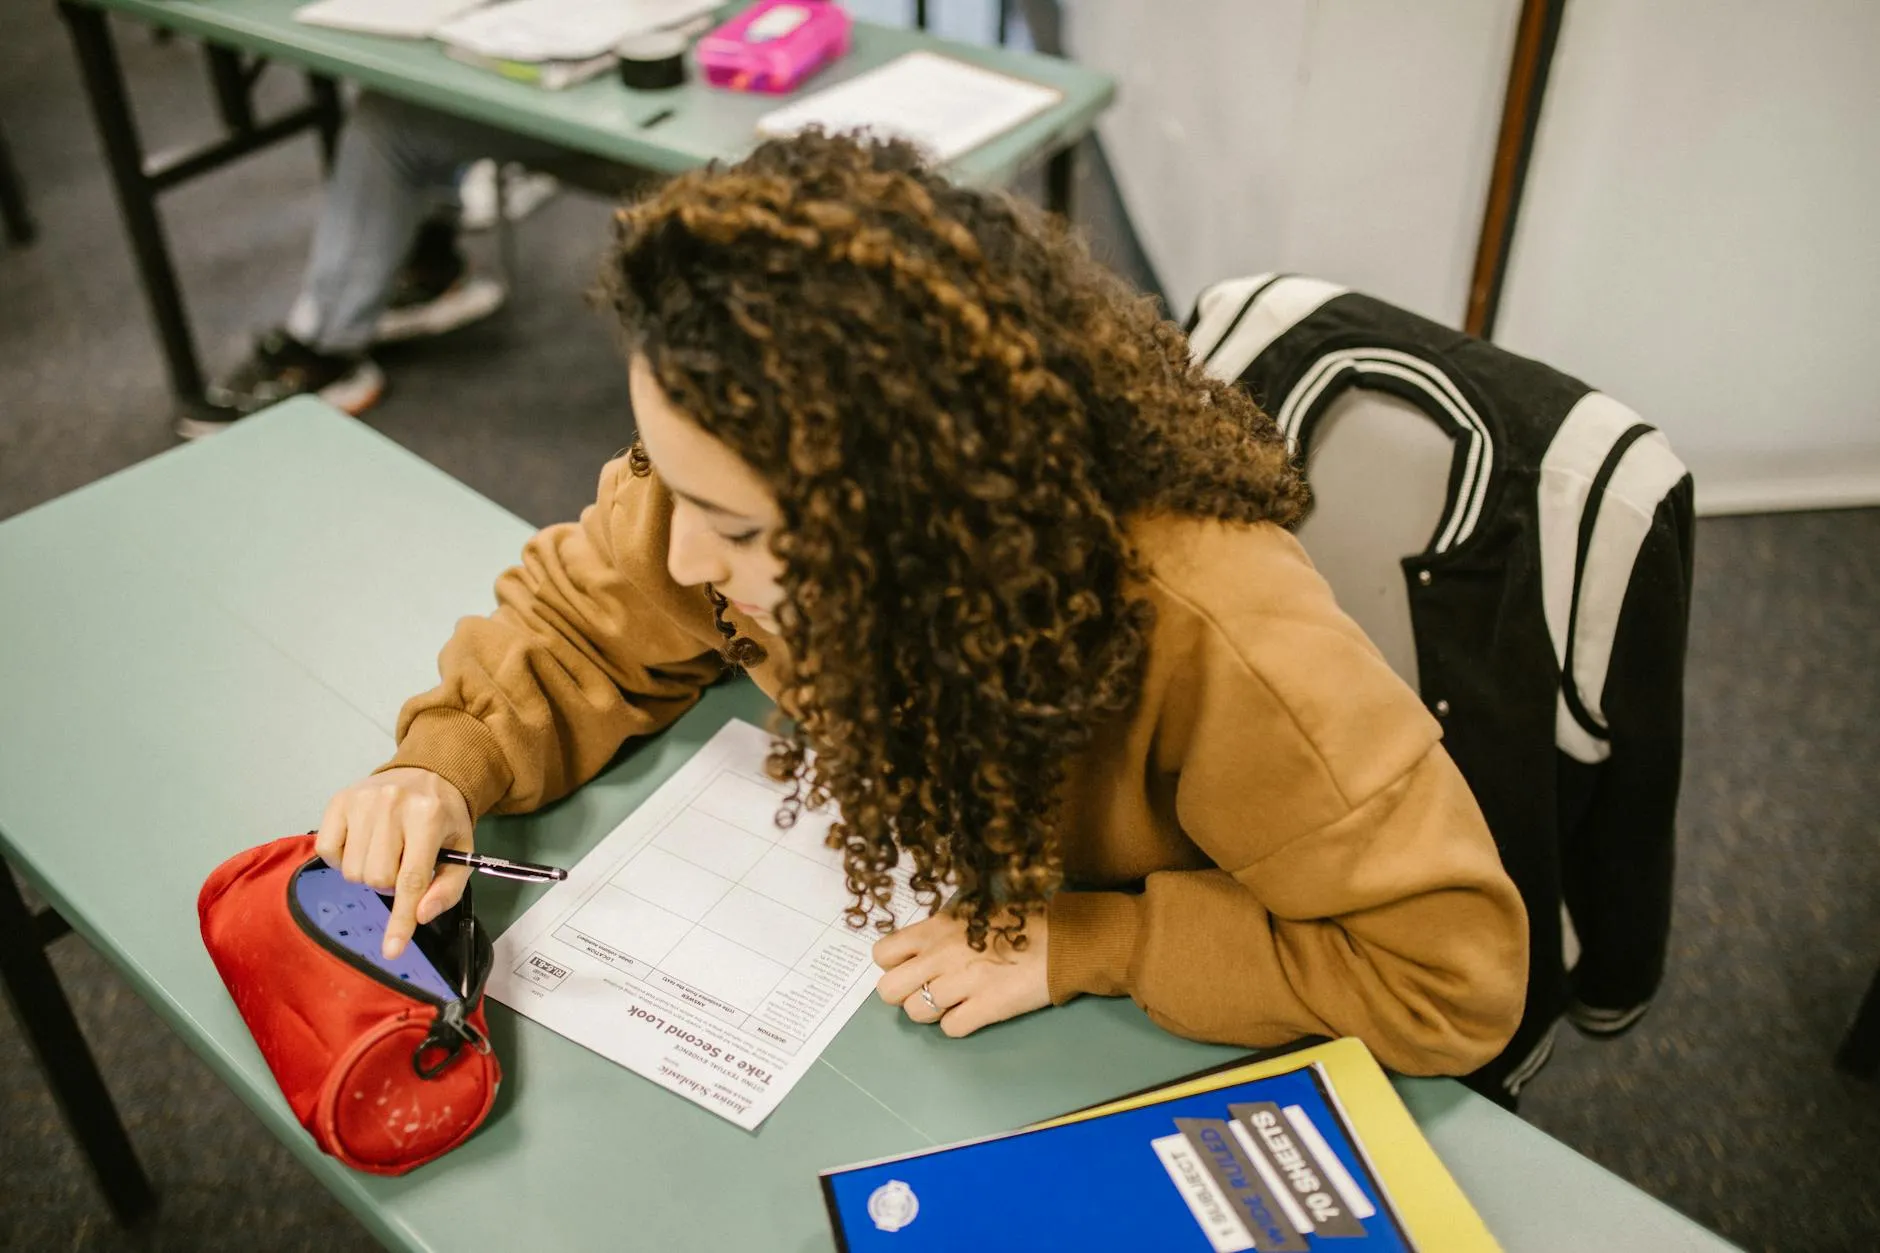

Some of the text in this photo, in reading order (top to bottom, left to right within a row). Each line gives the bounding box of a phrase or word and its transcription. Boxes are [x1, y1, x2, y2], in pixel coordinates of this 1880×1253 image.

[586, 946, 613, 961] LOCATION
[531, 957, 565, 977] RI.6-8.1
[680, 993, 705, 1007] ANSWER
[627, 1004, 665, 1030] Look
[665, 1024, 722, 1058] Second
[756, 1026, 786, 1043] QUESTION
[673, 1043, 708, 1064] EVIDENCE
[724, 1052, 736, 1063] a
[708, 1061, 740, 1080] TEXTUAL
[736, 1058, 774, 1085] Take
[659, 1065, 746, 1115] Junior Scholastic
[740, 1078, 765, 1093] CITING
[1251, 1110, 1340, 1222] 70 SHEETS
[1171, 1151, 1229, 1224] SUBJECT
[1201, 1127, 1286, 1245] WIDE RULED
